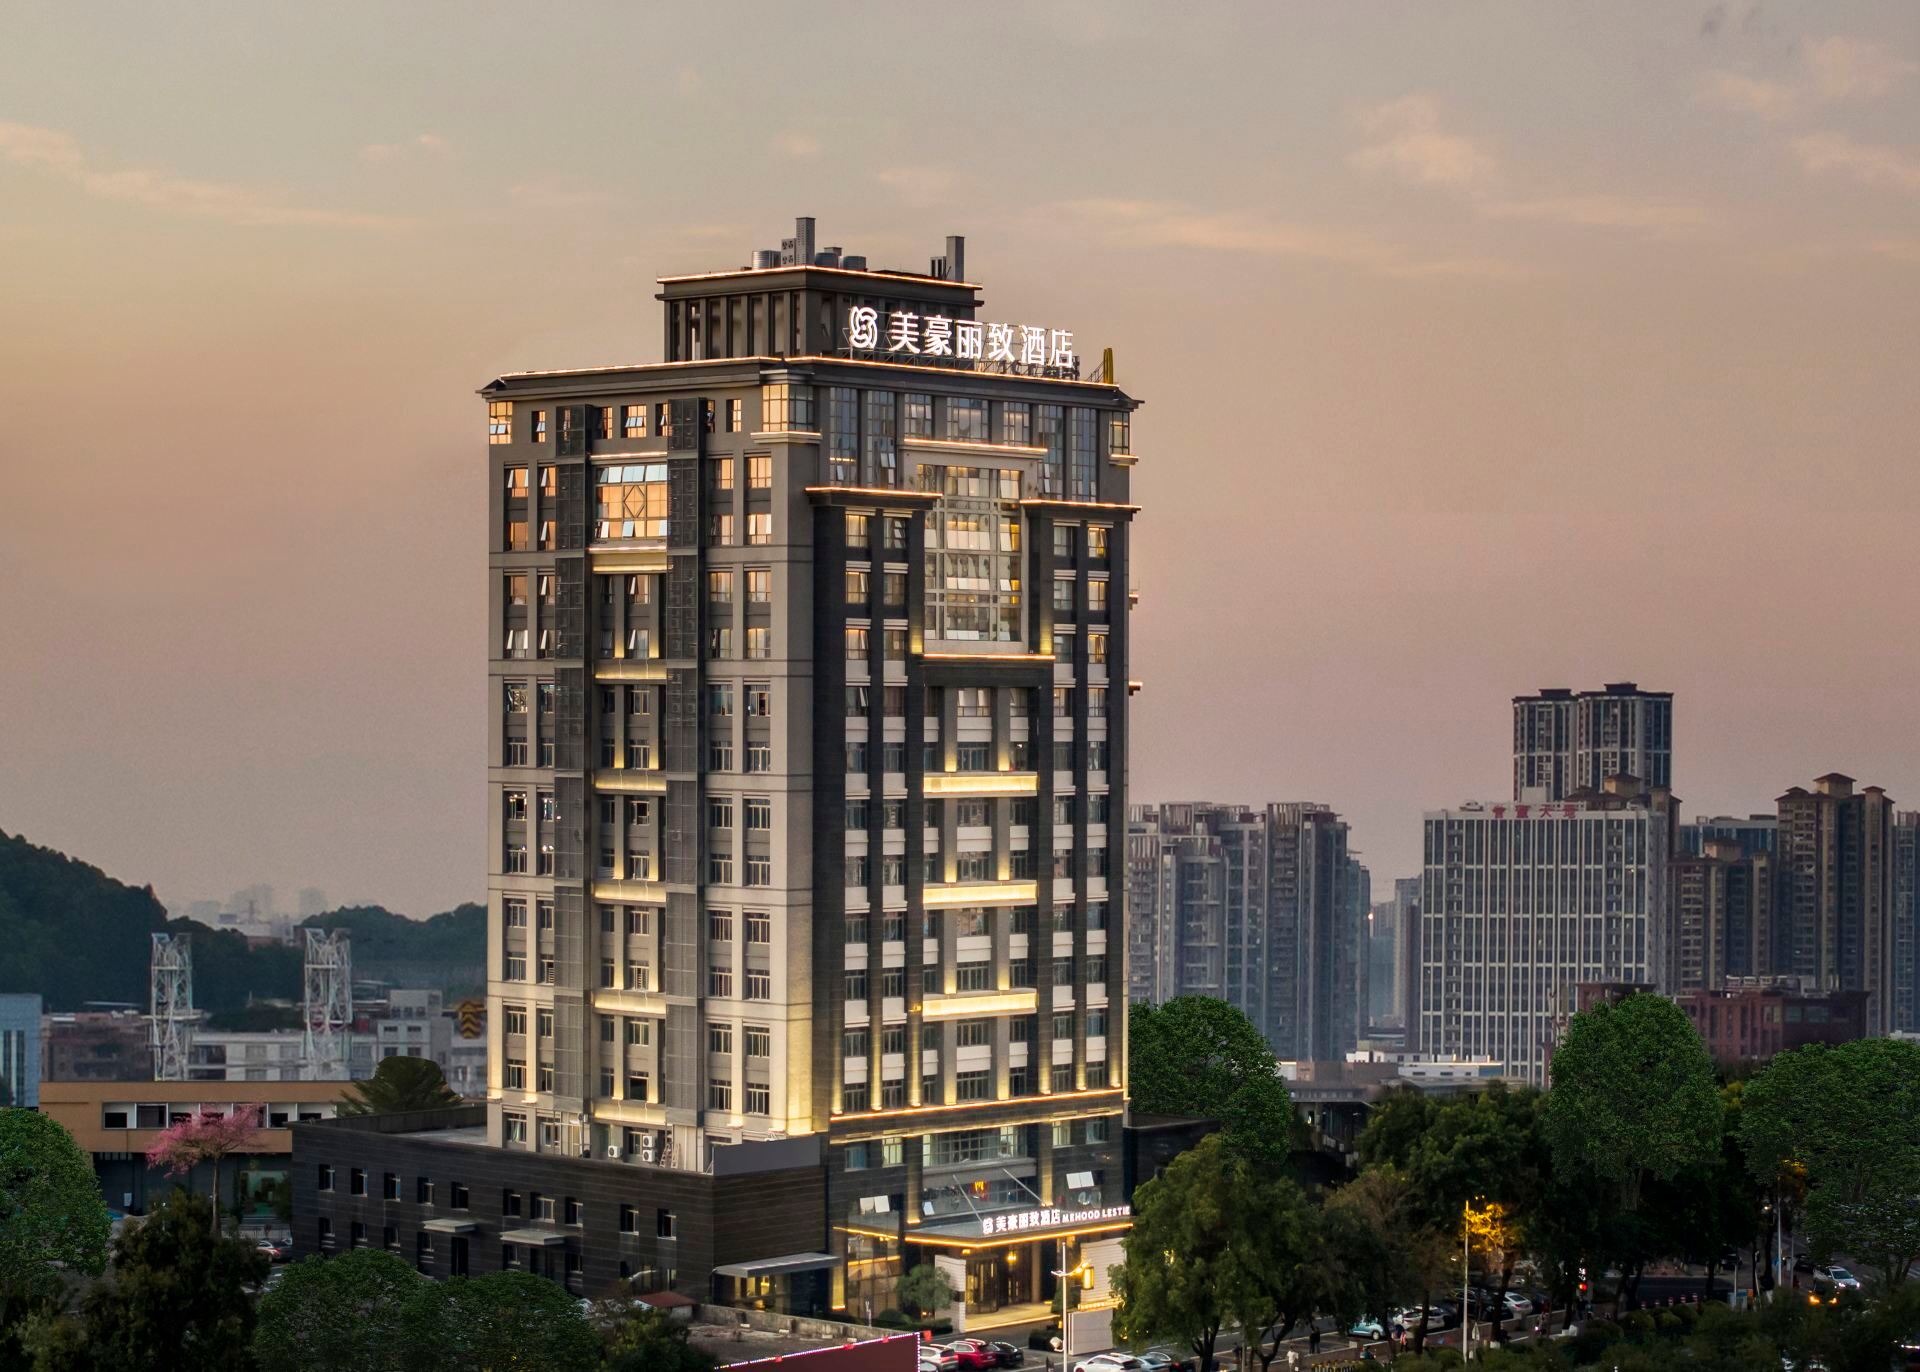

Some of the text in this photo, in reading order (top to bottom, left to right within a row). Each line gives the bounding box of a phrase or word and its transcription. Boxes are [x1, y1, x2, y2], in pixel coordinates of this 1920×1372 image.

[888, 311, 1074, 368] 美豪丽致酒店
[996, 1209, 1061, 1233] 美豪丽致酒店
[1062, 1210, 1100, 1223] MEHOOD
